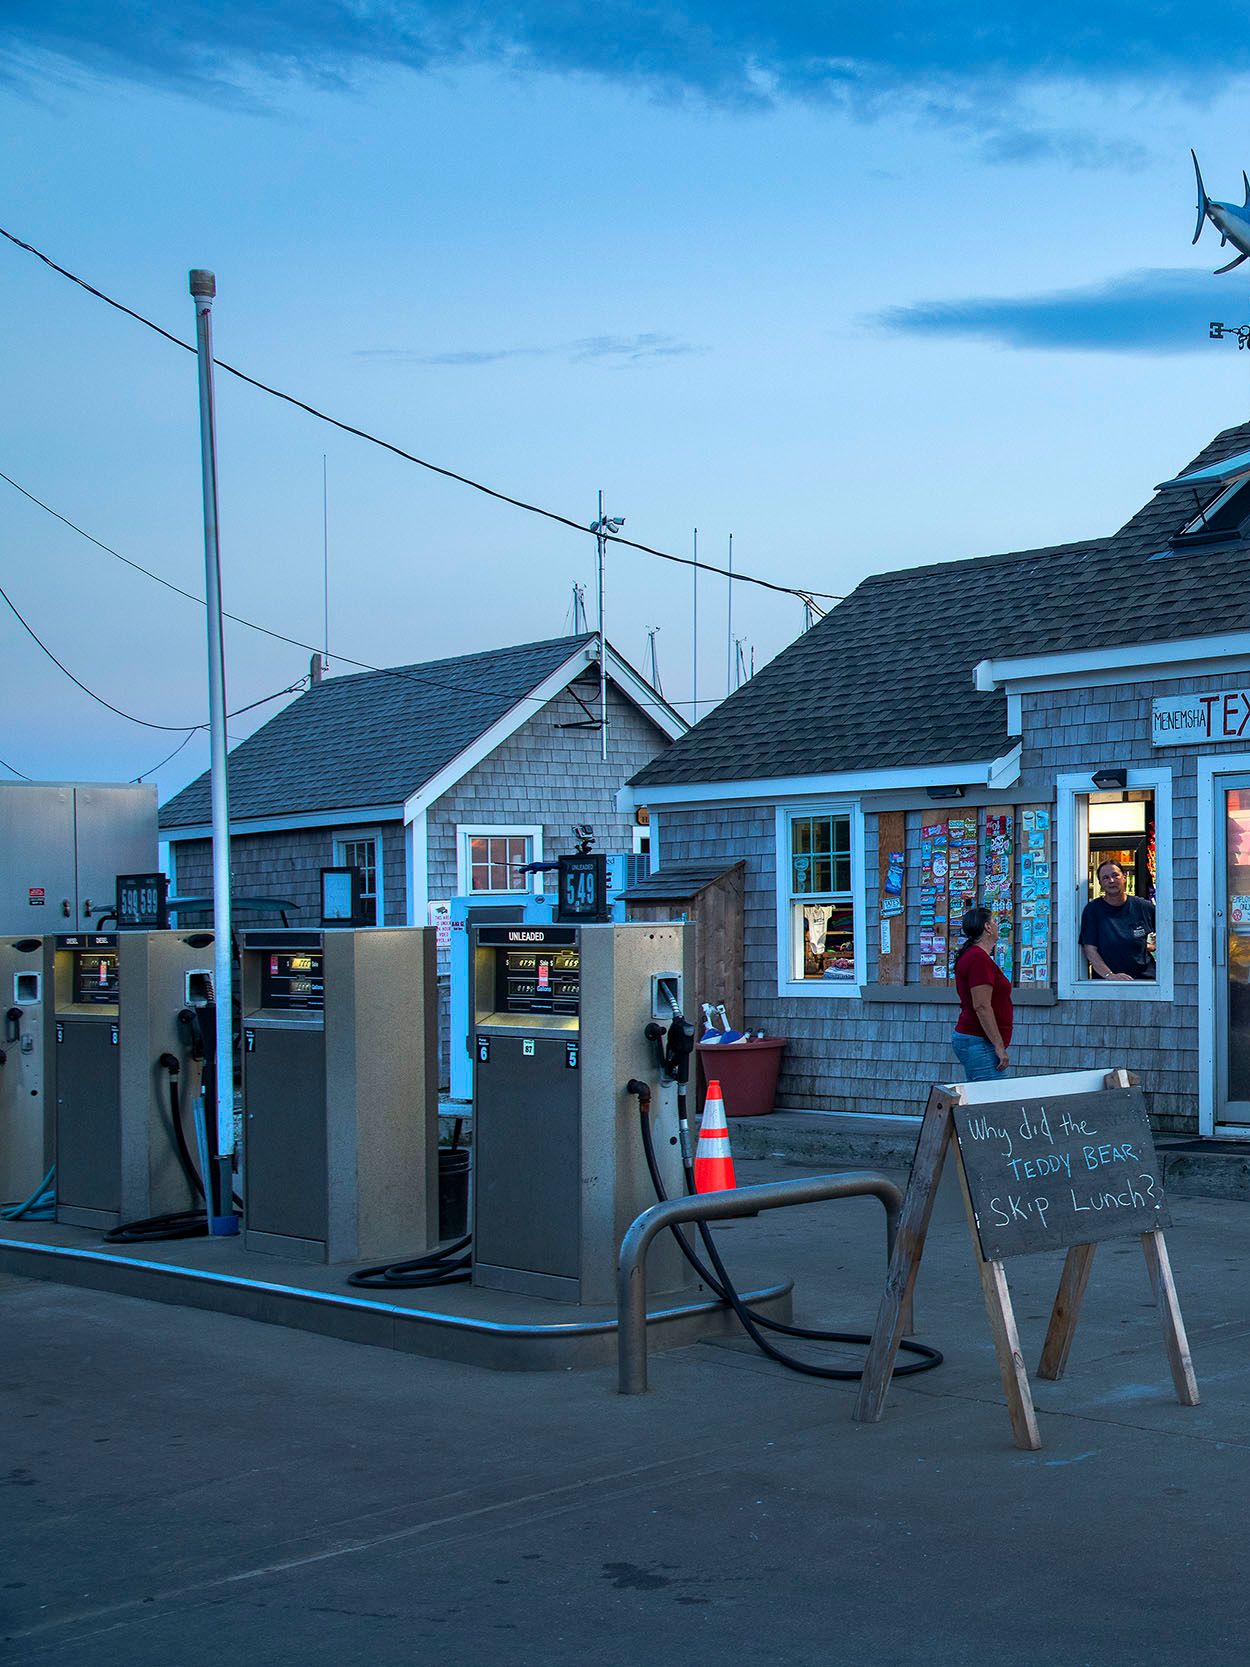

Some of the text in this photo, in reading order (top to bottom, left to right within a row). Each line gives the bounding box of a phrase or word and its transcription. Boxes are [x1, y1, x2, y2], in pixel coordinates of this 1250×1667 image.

[1153, 709, 1206, 731] MENEMSHA
[508, 931, 545, 942] UNLEADED
[248, 1038, 254, 1052] 7
[524, 1045, 533, 1054] 87
[480, 1046, 488, 1061] 6
[569, 1051, 577, 1067] 5
[968, 1106, 1097, 1158] Why did the
[1006, 1143, 1139, 1182] TEDDY BEAR
[1070, 1174, 1162, 1212] Lunch?
